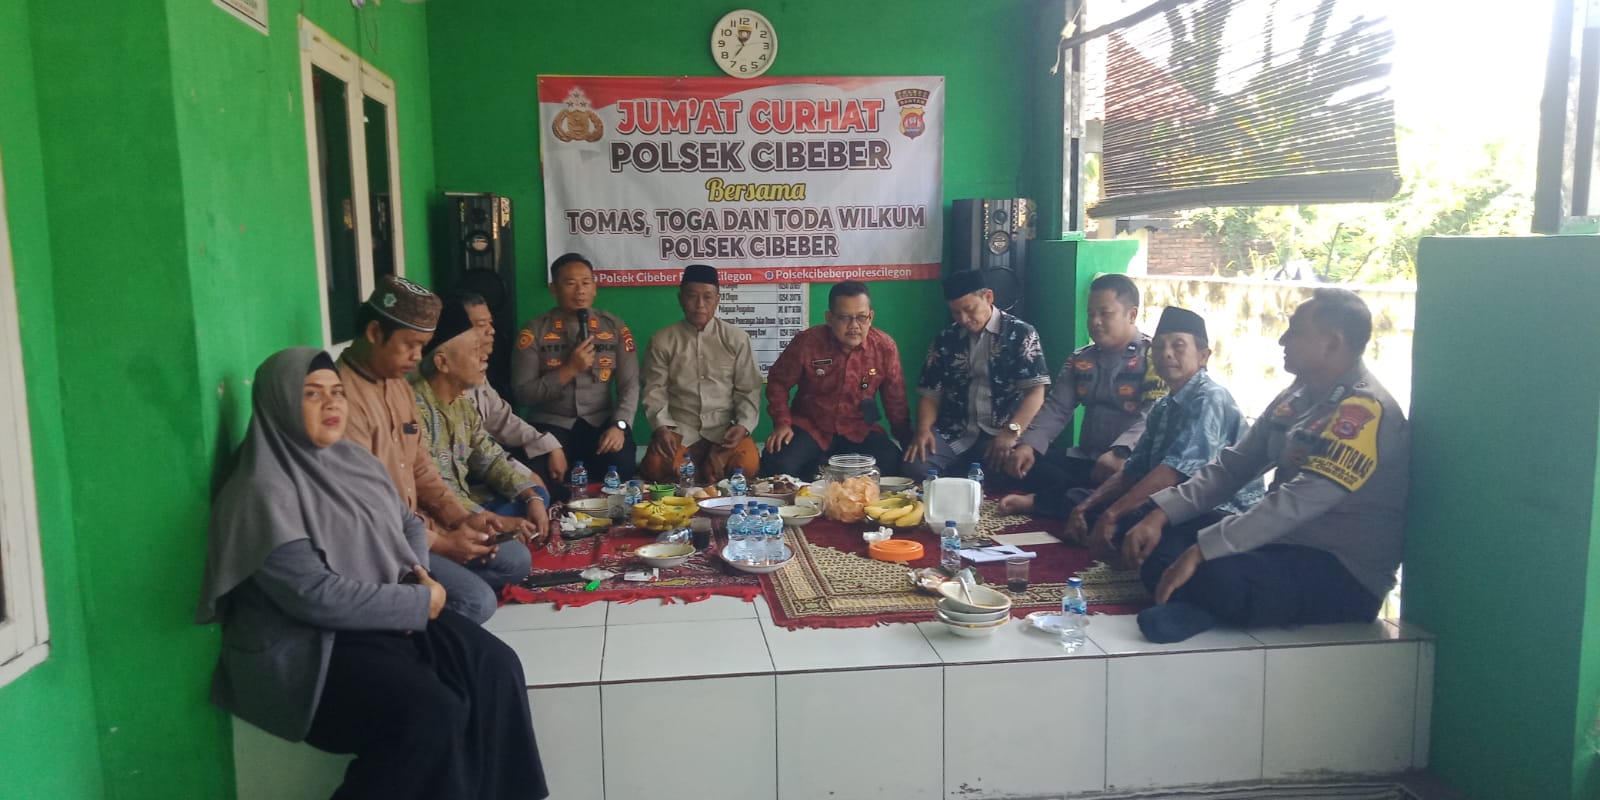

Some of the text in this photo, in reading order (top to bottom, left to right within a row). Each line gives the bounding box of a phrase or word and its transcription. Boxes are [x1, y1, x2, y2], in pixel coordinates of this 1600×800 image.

[730, 20, 736, 28] 11
[739, 17, 750, 26] 12
[721, 28, 732, 37] 10
[760, 30, 767, 39] 2
[718, 40, 726, 48] 9
[763, 42, 770, 50] 3
[721, 51, 729, 60] 8
[730, 60, 737, 68] 7
[740, 64, 748, 73] 6
[751, 61, 759, 69] 5
[749, 98, 885, 134] CURHAT
[610, 139, 893, 173] POLSEK CIBEBER
[705, 177, 807, 203] Bersama
[565, 204, 927, 237] TOMAS, TOGA DAN TODA WILKUM
[659, 232, 840, 260] POLSEK CIBEBER
[600, 273, 634, 283] Polsek
[636, 271, 676, 283] Cibeber
[775, 267, 912, 280] Polsekcibeberpolrescilegon
